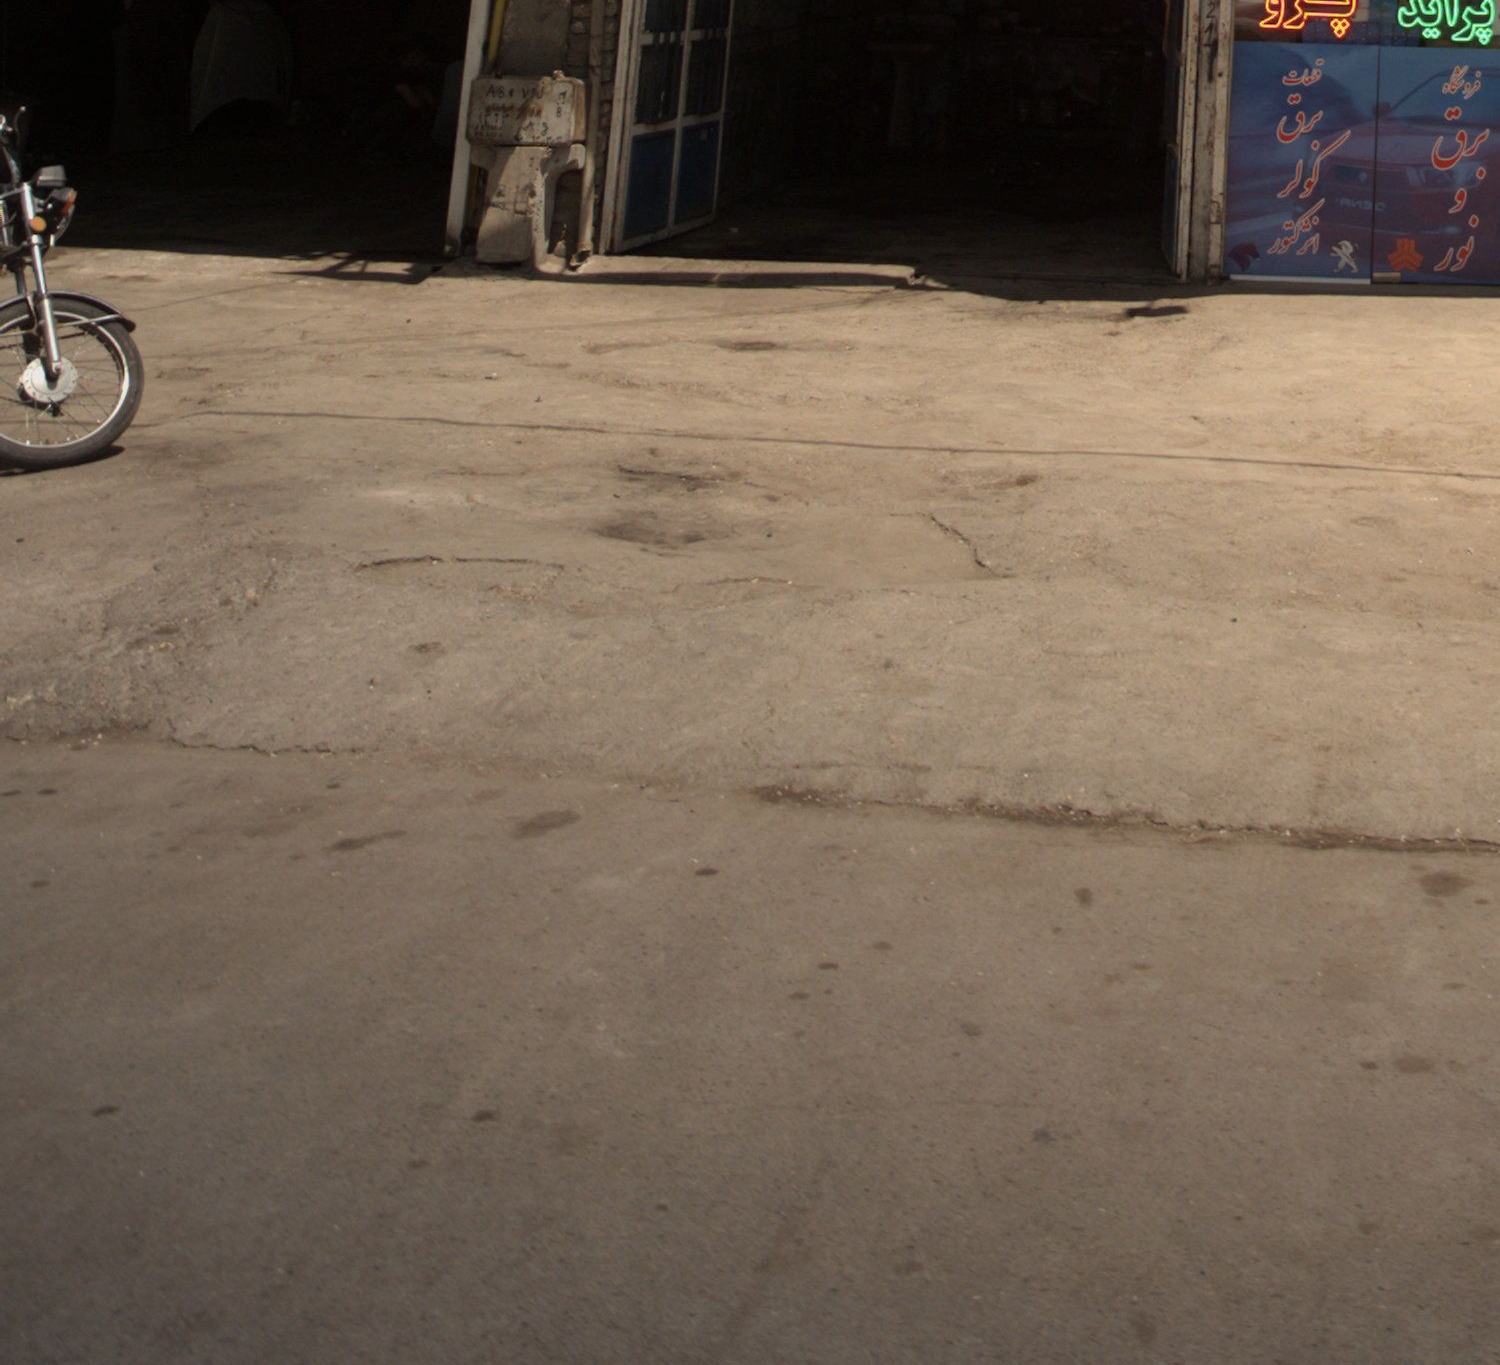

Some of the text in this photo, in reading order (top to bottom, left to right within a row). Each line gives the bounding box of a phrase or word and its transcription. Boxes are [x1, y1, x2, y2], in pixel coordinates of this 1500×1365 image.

[1276, 92, 1323, 150] برق
[1431, 106, 1490, 180] برق
[1276, 129, 1351, 199] کولر
[1448, 187, 1468, 214] و
[1433, 213, 1480, 273] نور
